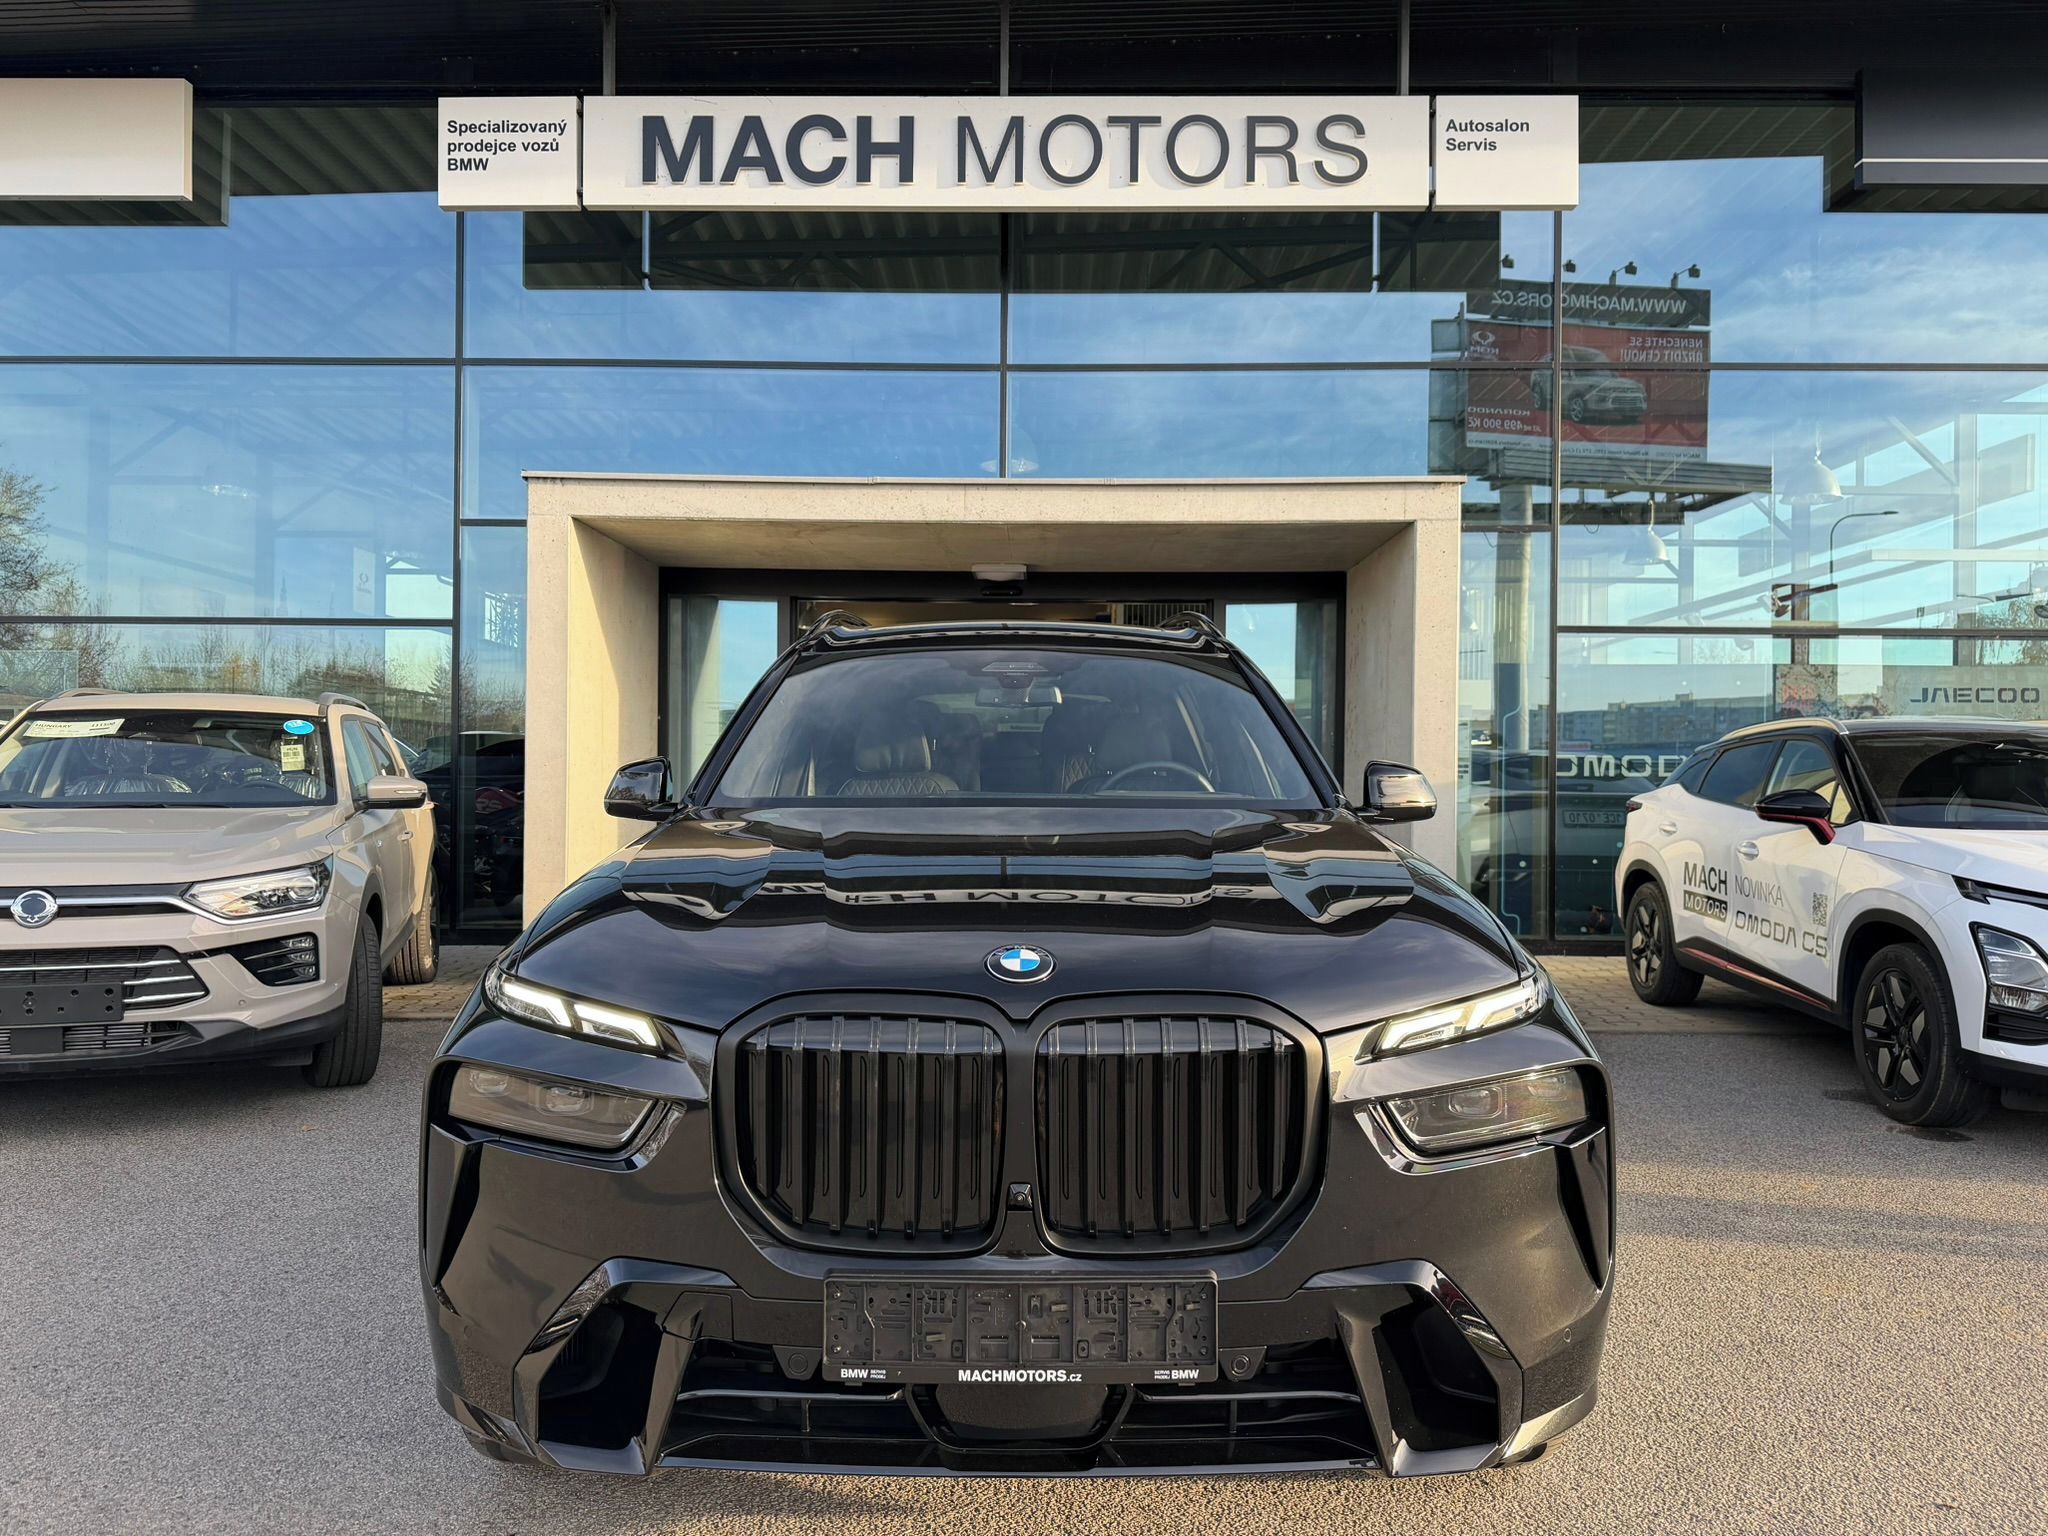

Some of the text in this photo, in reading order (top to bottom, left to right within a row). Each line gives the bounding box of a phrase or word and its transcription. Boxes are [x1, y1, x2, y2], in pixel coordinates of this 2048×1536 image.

[447, 119, 567, 136] Specializovaný
[1445, 118, 1530, 132] Autosalon
[447, 138, 560, 155] prodejce vozů
[641, 114, 1369, 186] MACH MOTORS
[1445, 137, 1497, 151] Servis
[447, 157, 489, 171] BMW
[1910, 687, 2040, 704] JAECOO
[1556, 754, 1686, 777] OMOD
[1683, 861, 1784, 907] MACH NOVINKA
[1684, 893, 1727, 920] MOTORS
[1735, 910, 1797, 948] OMODA
[840, 1368, 868, 1379] BMW
[958, 1368, 1082, 1382] MACHMOTORS.cz
[1171, 1369, 1199, 1380] BMW
